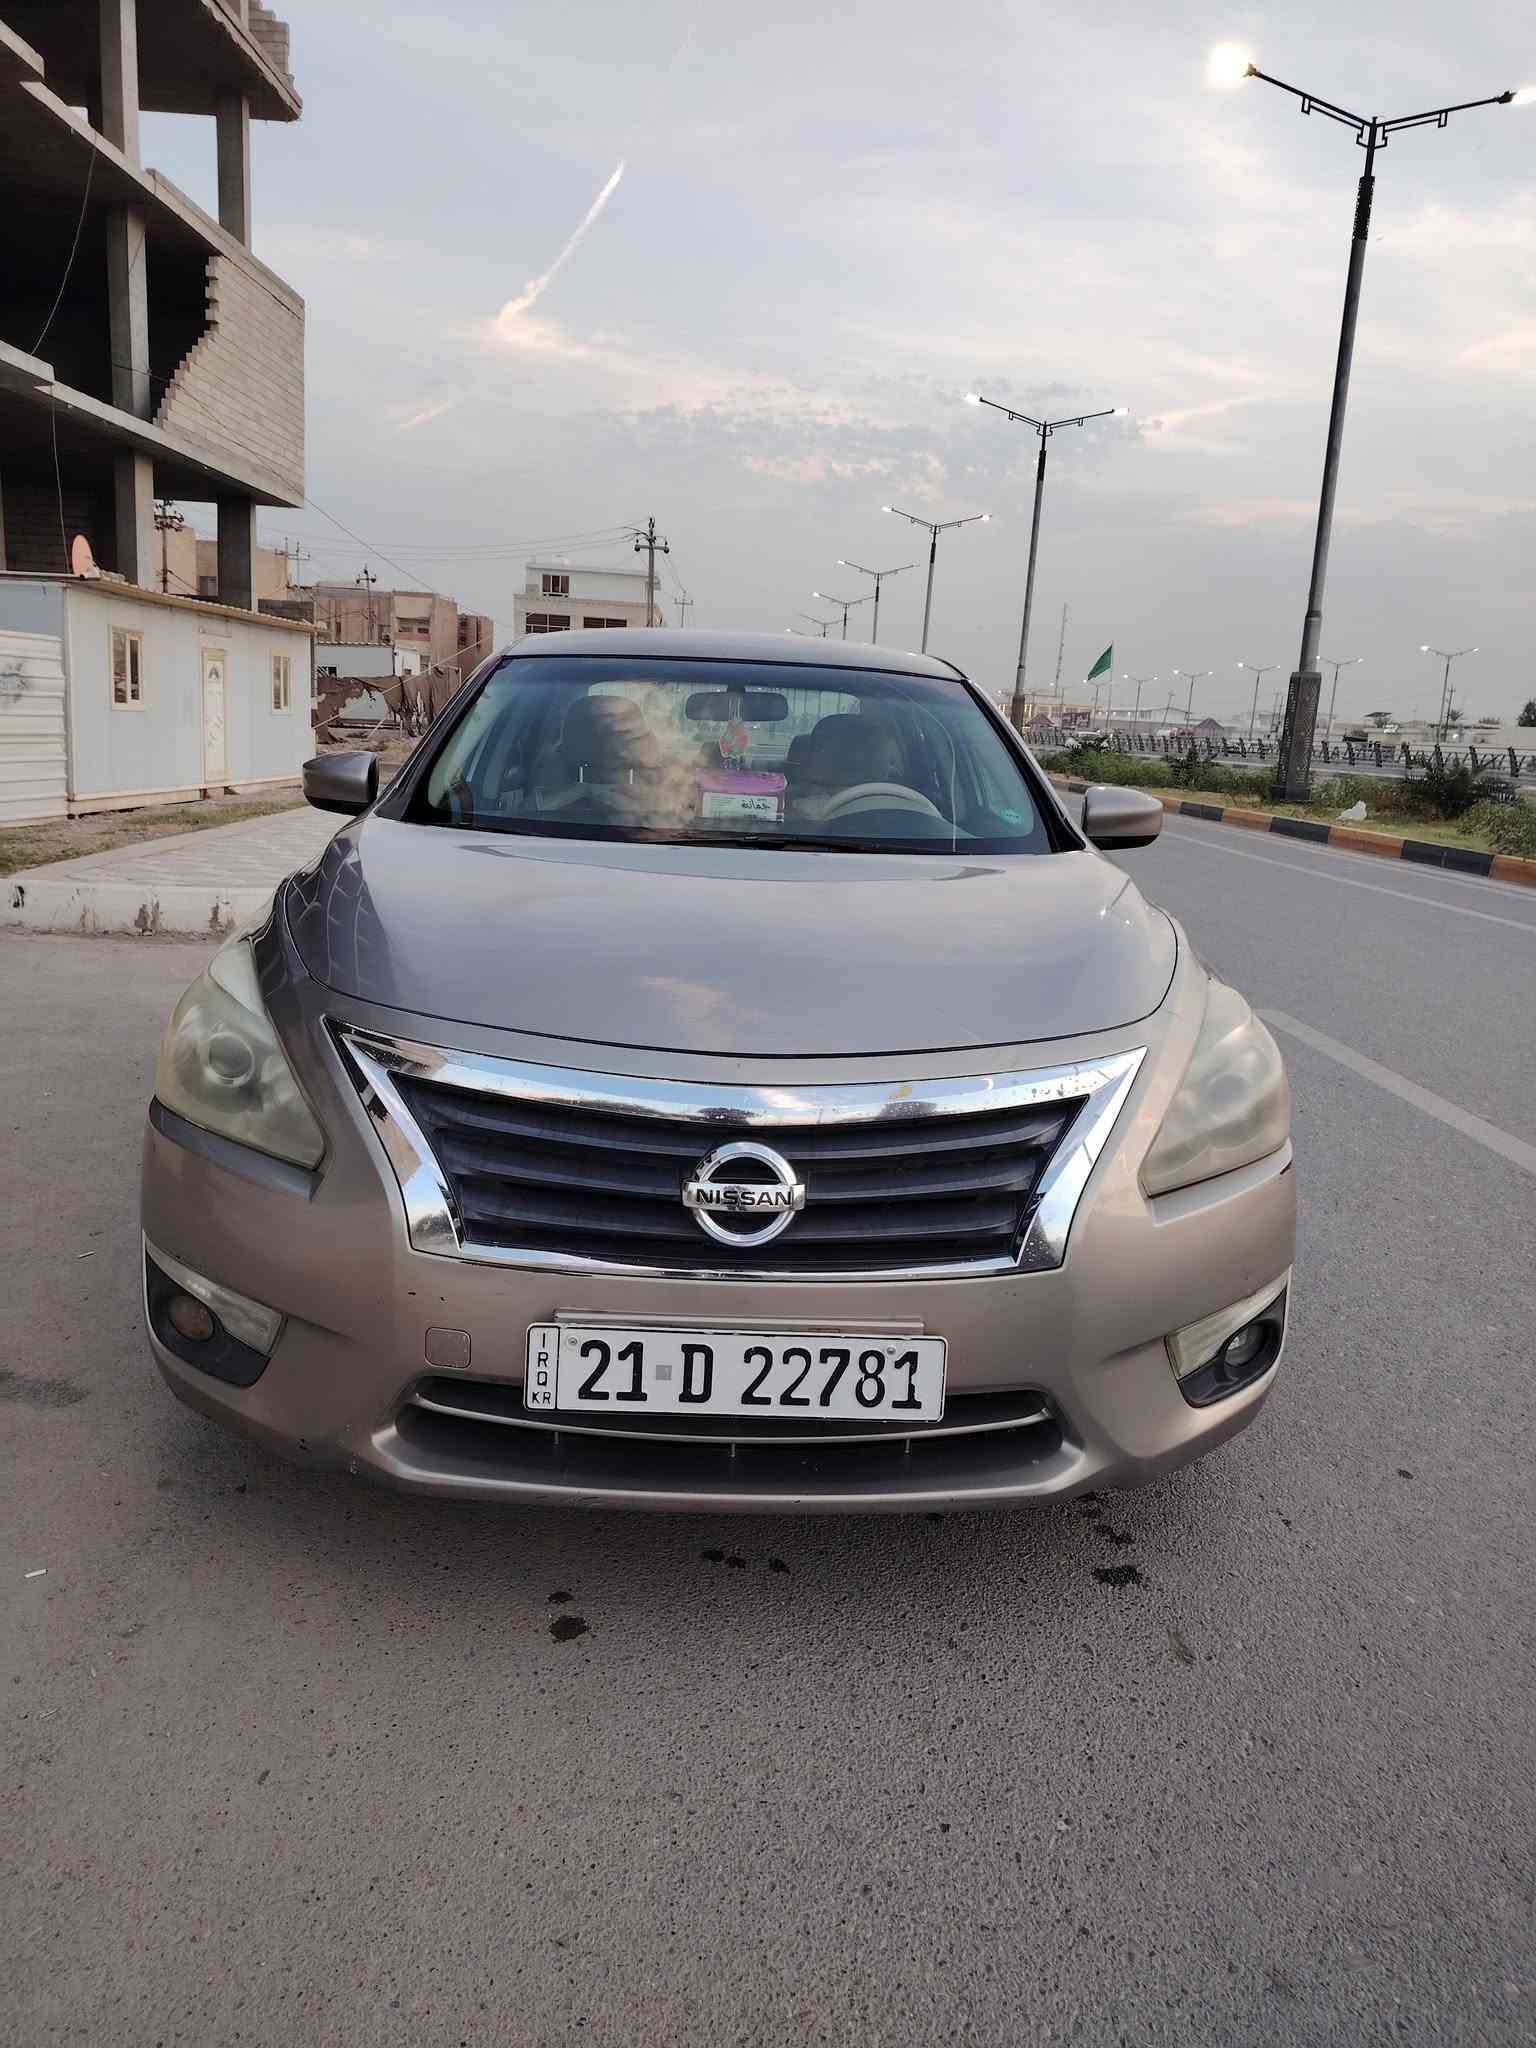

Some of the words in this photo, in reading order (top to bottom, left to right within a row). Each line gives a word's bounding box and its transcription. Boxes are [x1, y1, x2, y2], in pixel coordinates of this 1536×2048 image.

[696, 1188, 792, 1206] NISSAN
[577, 1339, 648, 1402] 21
[678, 1343, 714, 1404] D
[740, 1346, 923, 1410] 22781
[531, 1391, 552, 1405] KR
